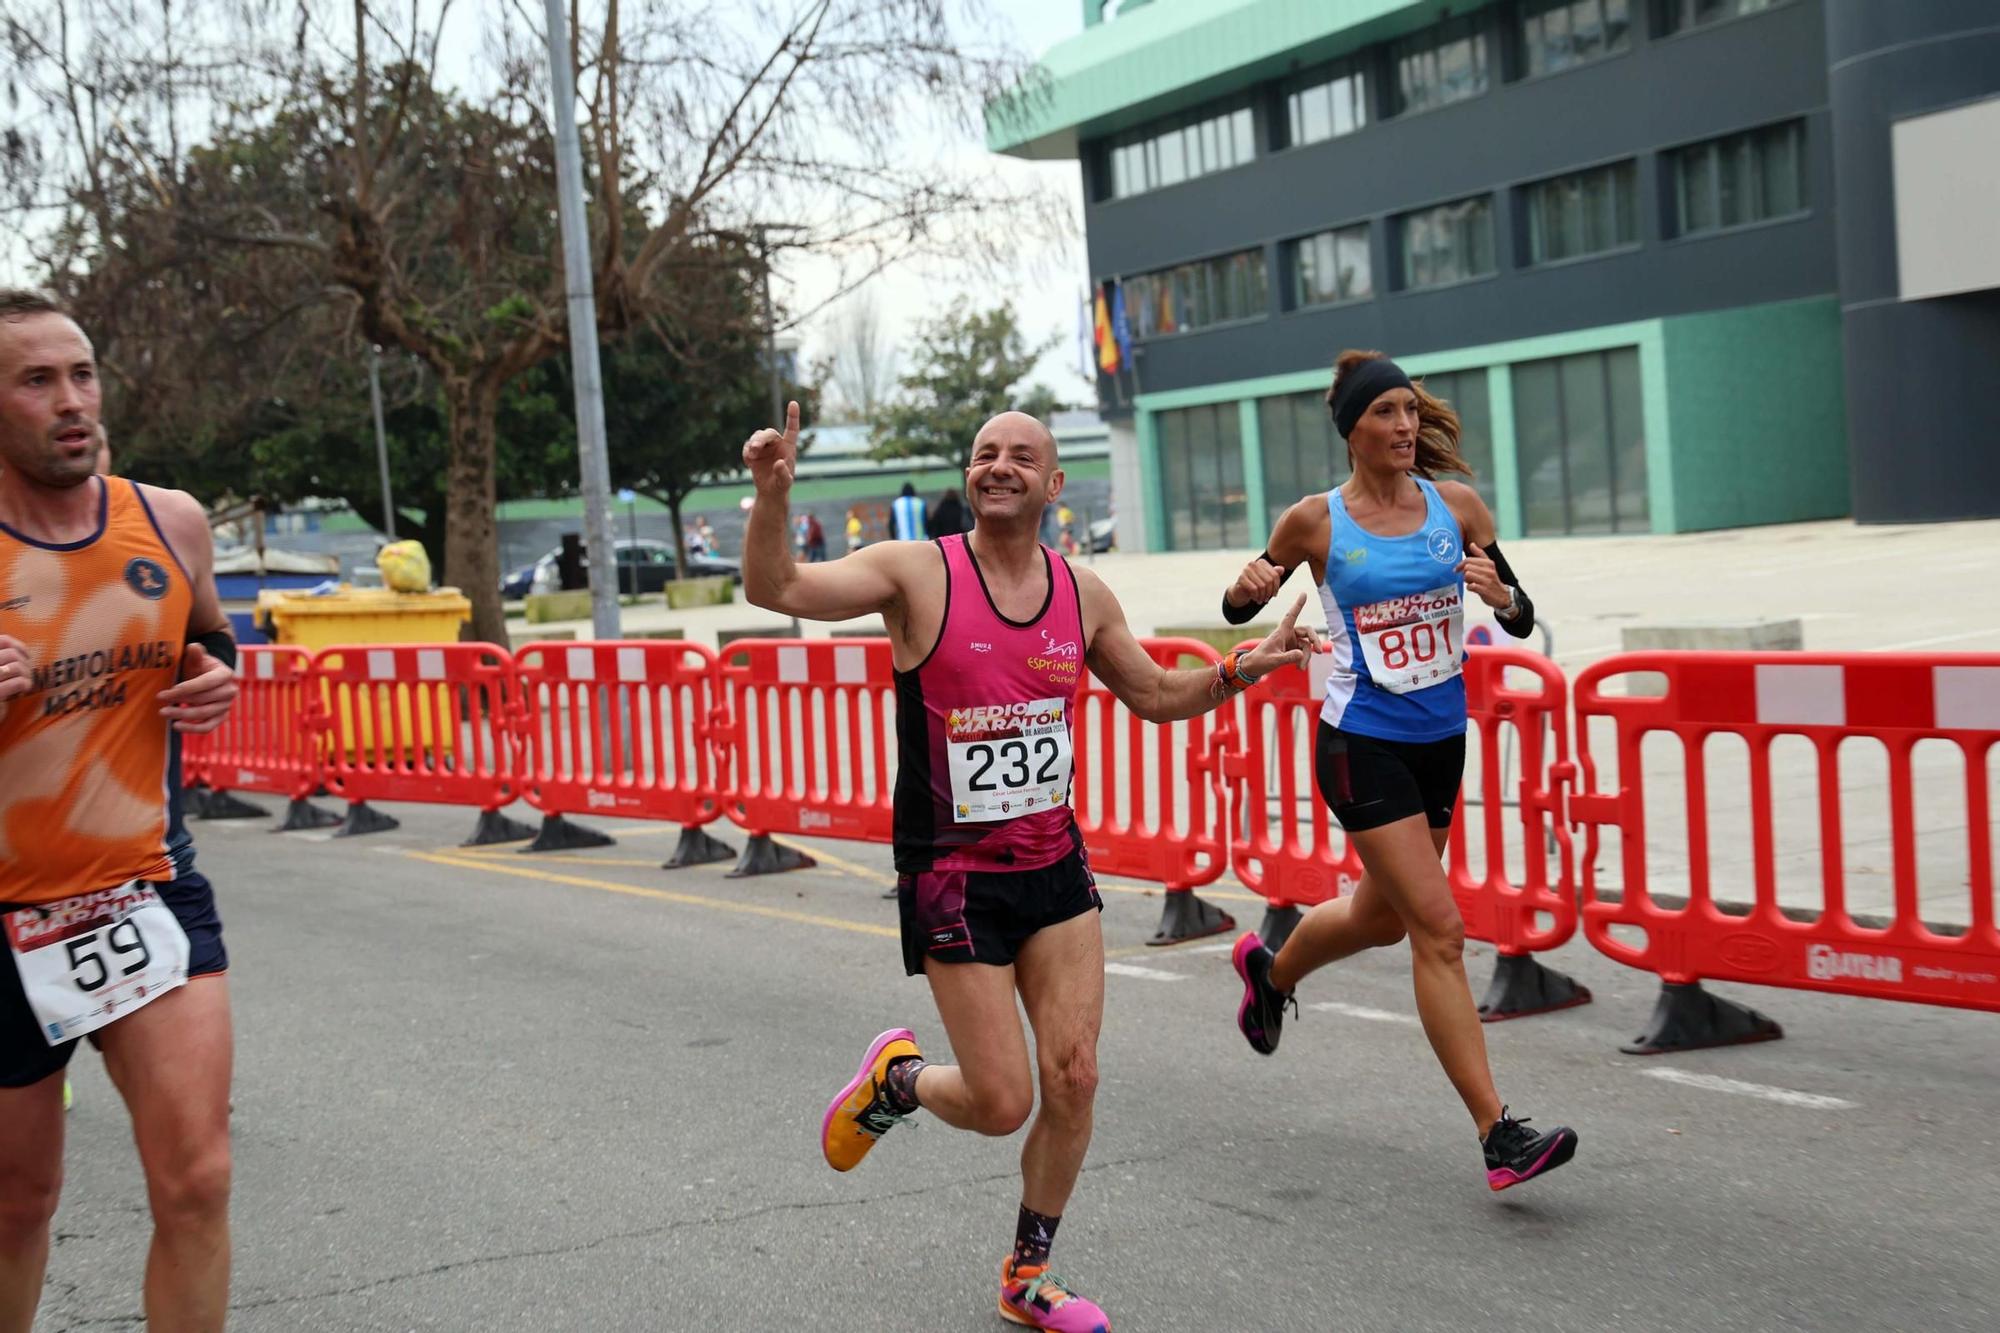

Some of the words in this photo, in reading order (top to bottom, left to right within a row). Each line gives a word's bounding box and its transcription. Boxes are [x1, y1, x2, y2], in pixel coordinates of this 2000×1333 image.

[1359, 593, 1425, 615] MEDIO
[1361, 595, 1458, 626] MARATÓN
[1378, 618, 1453, 670] 801
[951, 702, 1029, 721] MEDIO
[952, 710, 1063, 734] MARATÓN
[966, 737, 1059, 791] 232
[66, 918, 151, 992] 59
